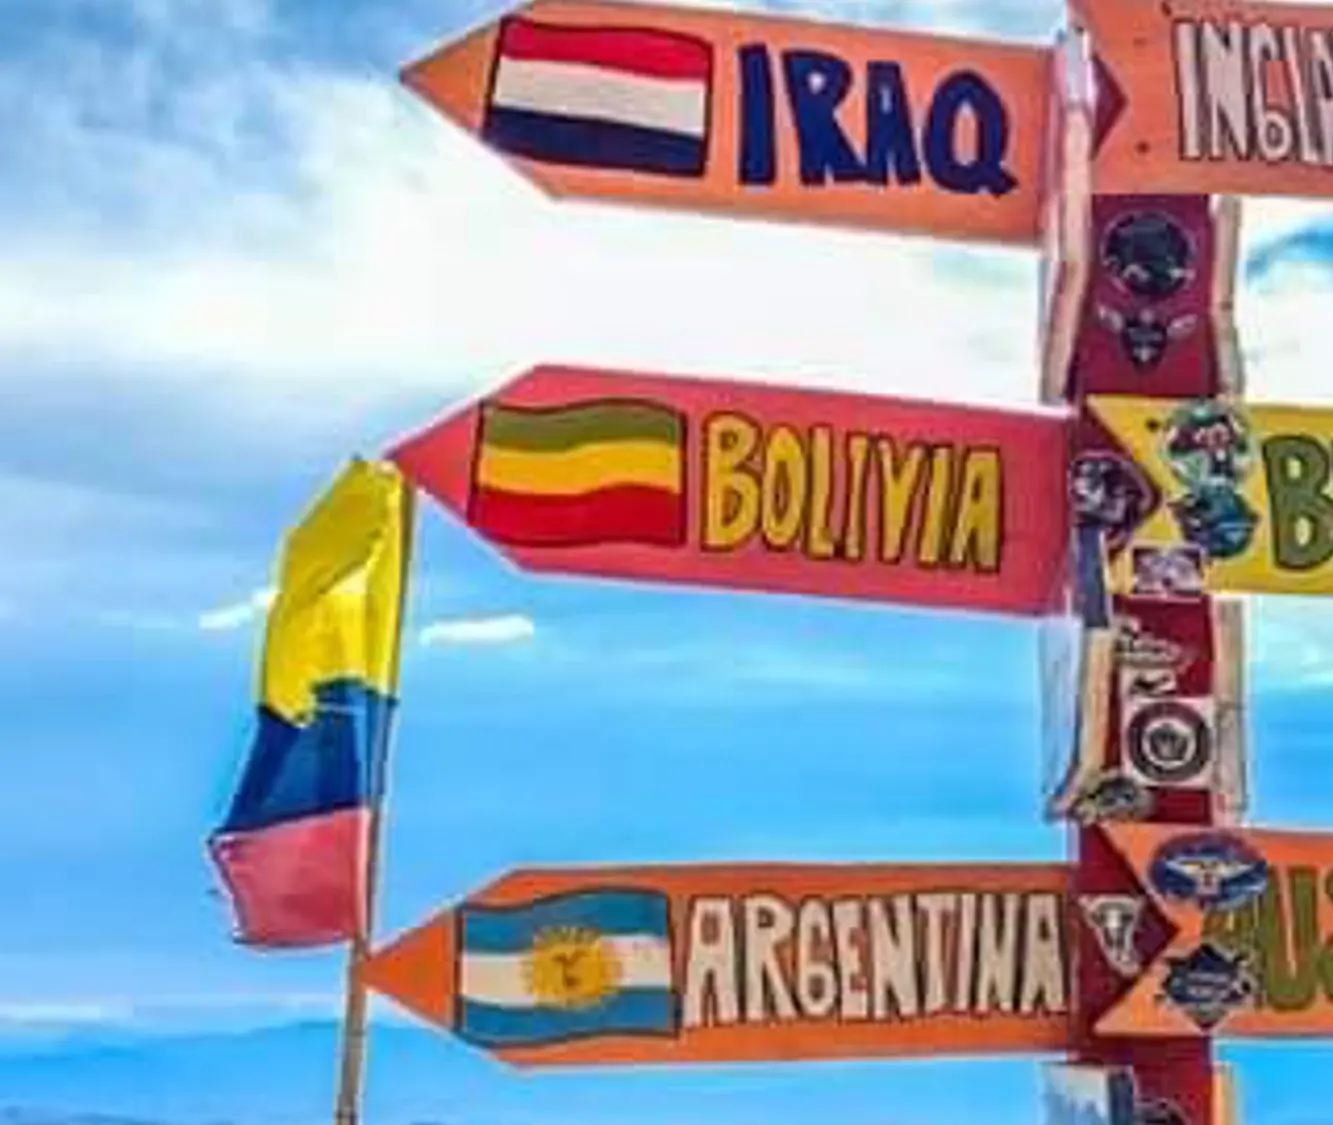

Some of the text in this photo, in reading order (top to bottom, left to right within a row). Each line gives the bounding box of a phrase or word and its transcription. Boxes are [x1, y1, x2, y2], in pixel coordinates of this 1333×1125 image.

[737, 44, 1017, 195] IRAQ
[701, 412, 1002, 572] BOLIVIA
[681, 892, 1067, 1026] ARGENTINA
